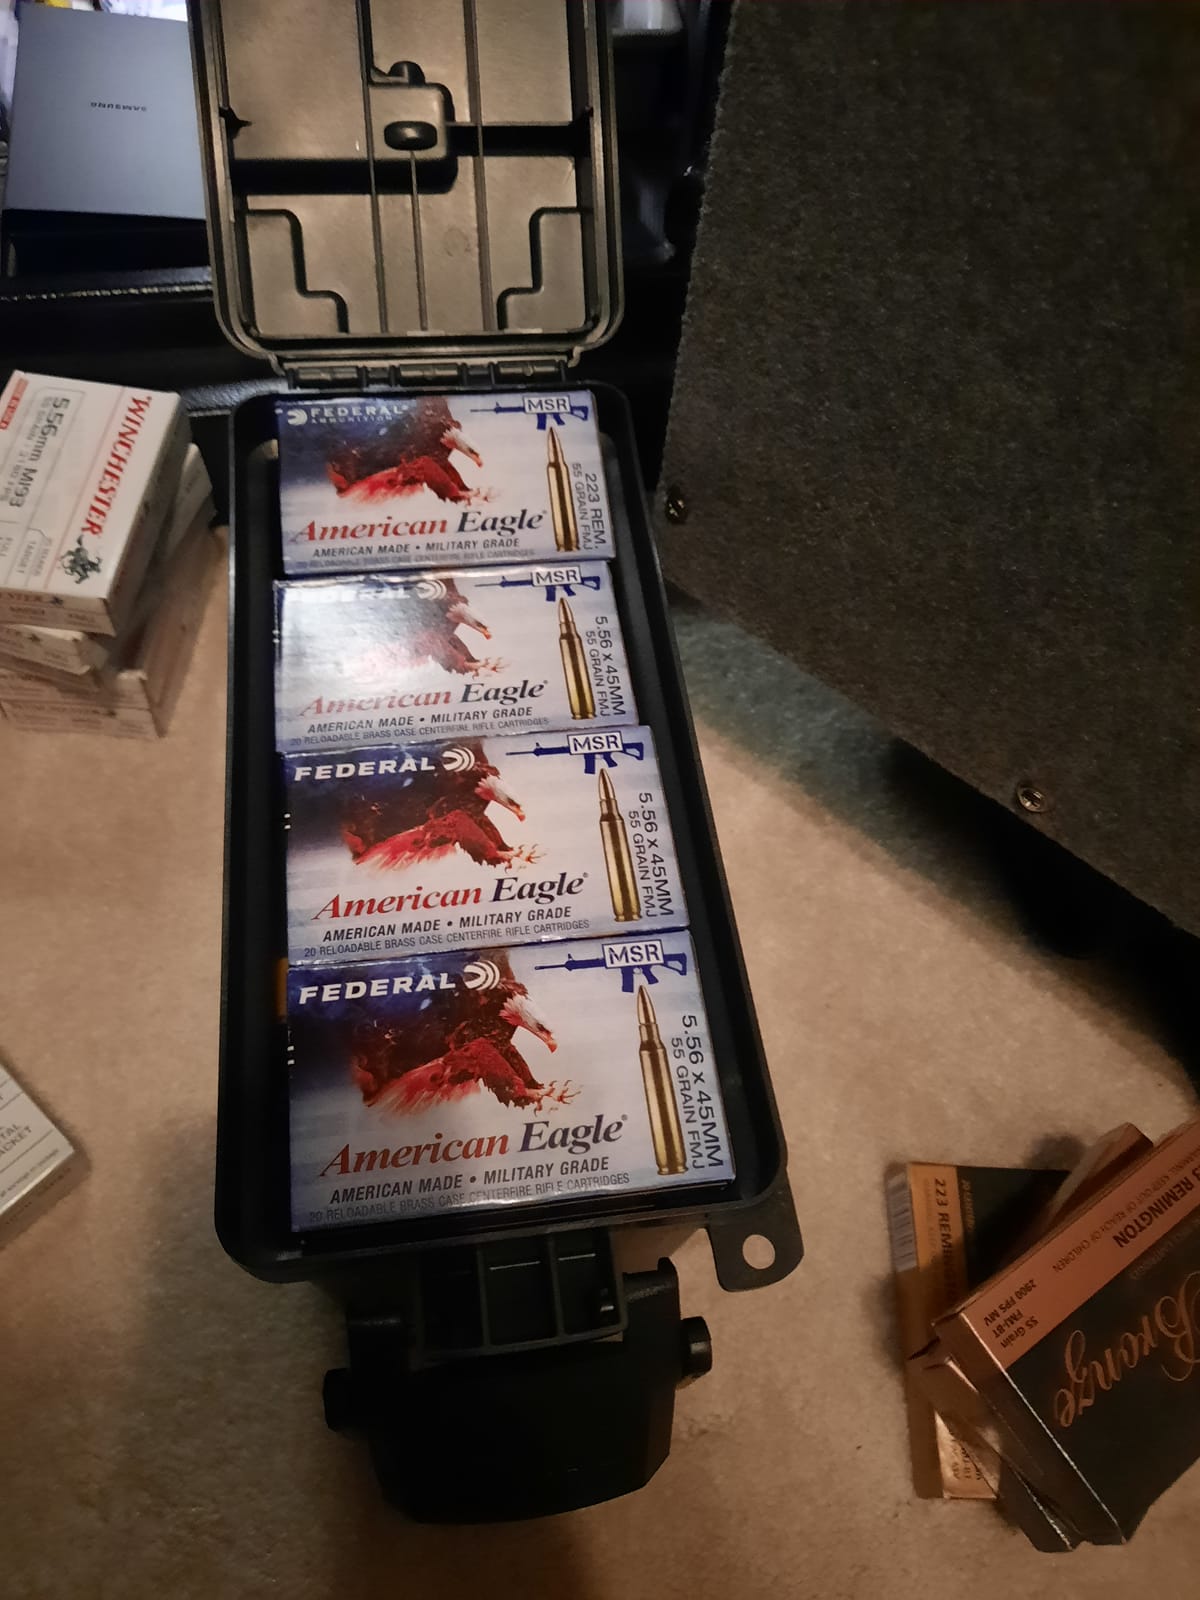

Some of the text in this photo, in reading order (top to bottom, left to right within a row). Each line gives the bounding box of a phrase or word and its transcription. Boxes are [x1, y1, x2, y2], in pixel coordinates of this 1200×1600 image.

[311, 405, 403, 417] FEDERAL
[527, 397, 569, 413] MSR
[80, 396, 150, 537] WINCHESTER
[572, 462, 592, 551] 55 GRAIN FMJ
[584, 473, 608, 551] 223 REM.
[290, 516, 448, 544] American
[313, 537, 520, 558] AMERICAN MADE MILITARY GRADE
[536, 568, 578, 584] MSR
[585, 630, 610, 717] 55 GRAIN FMJ
[595, 615, 613, 649] 5.56
[605, 664, 627, 716] 45MM
[299, 691, 451, 717] American
[307, 706, 534, 734] AMERICAN MADE MILITARY GRADE
[363, 729, 392, 740] BRASS
[394, 728, 417, 737] CASE
[472, 721, 496, 731] RIFLE
[571, 734, 621, 753] MSR
[294, 757, 436, 782] FEDERAL
[628, 810, 659, 918] 55 GRAIN FMJ
[638, 791, 659, 833] 5.56
[650, 853, 675, 917] 45MM
[310, 886, 482, 921] American
[304, 919, 590, 958] 20 RELOADABLE BRASS CASE CENTERFIRE RIFLE CARTRIDGES
[322, 906, 572, 943] AMERICAN MADE MILITARY GRADE
[607, 943, 661, 966] MSR
[298, 972, 457, 1006] FEDERAL
[671, 1037, 706, 1170] 55 GRAIN FMJ
[682, 1014, 705, 1066] 5.56
[697, 1090, 724, 1168] 45MM
[319, 1132, 510, 1178] American
[326, 1201, 399, 1222] RELOADABLE
[400, 1196, 435, 1212] BRASS
[439, 1192, 465, 1207] CASE
[469, 1184, 532, 1203] CENTERFIRE
[535, 1179, 564, 1196] RIFLE
[566, 1172, 631, 1191] CARTRIDGES
[329, 1156, 610, 1205] AMERICAN MADE MILITARY GRADE
[934, 1178, 949, 1207] 223
[1112, 1175, 1195, 1248] REMINGTON
[1052, 1238, 1091, 1273] CHILDREN
[983, 1308, 1001, 1327] MV
[998, 1295, 1017, 1313] FPS
[1000, 1326, 1026, 1349] Grain
